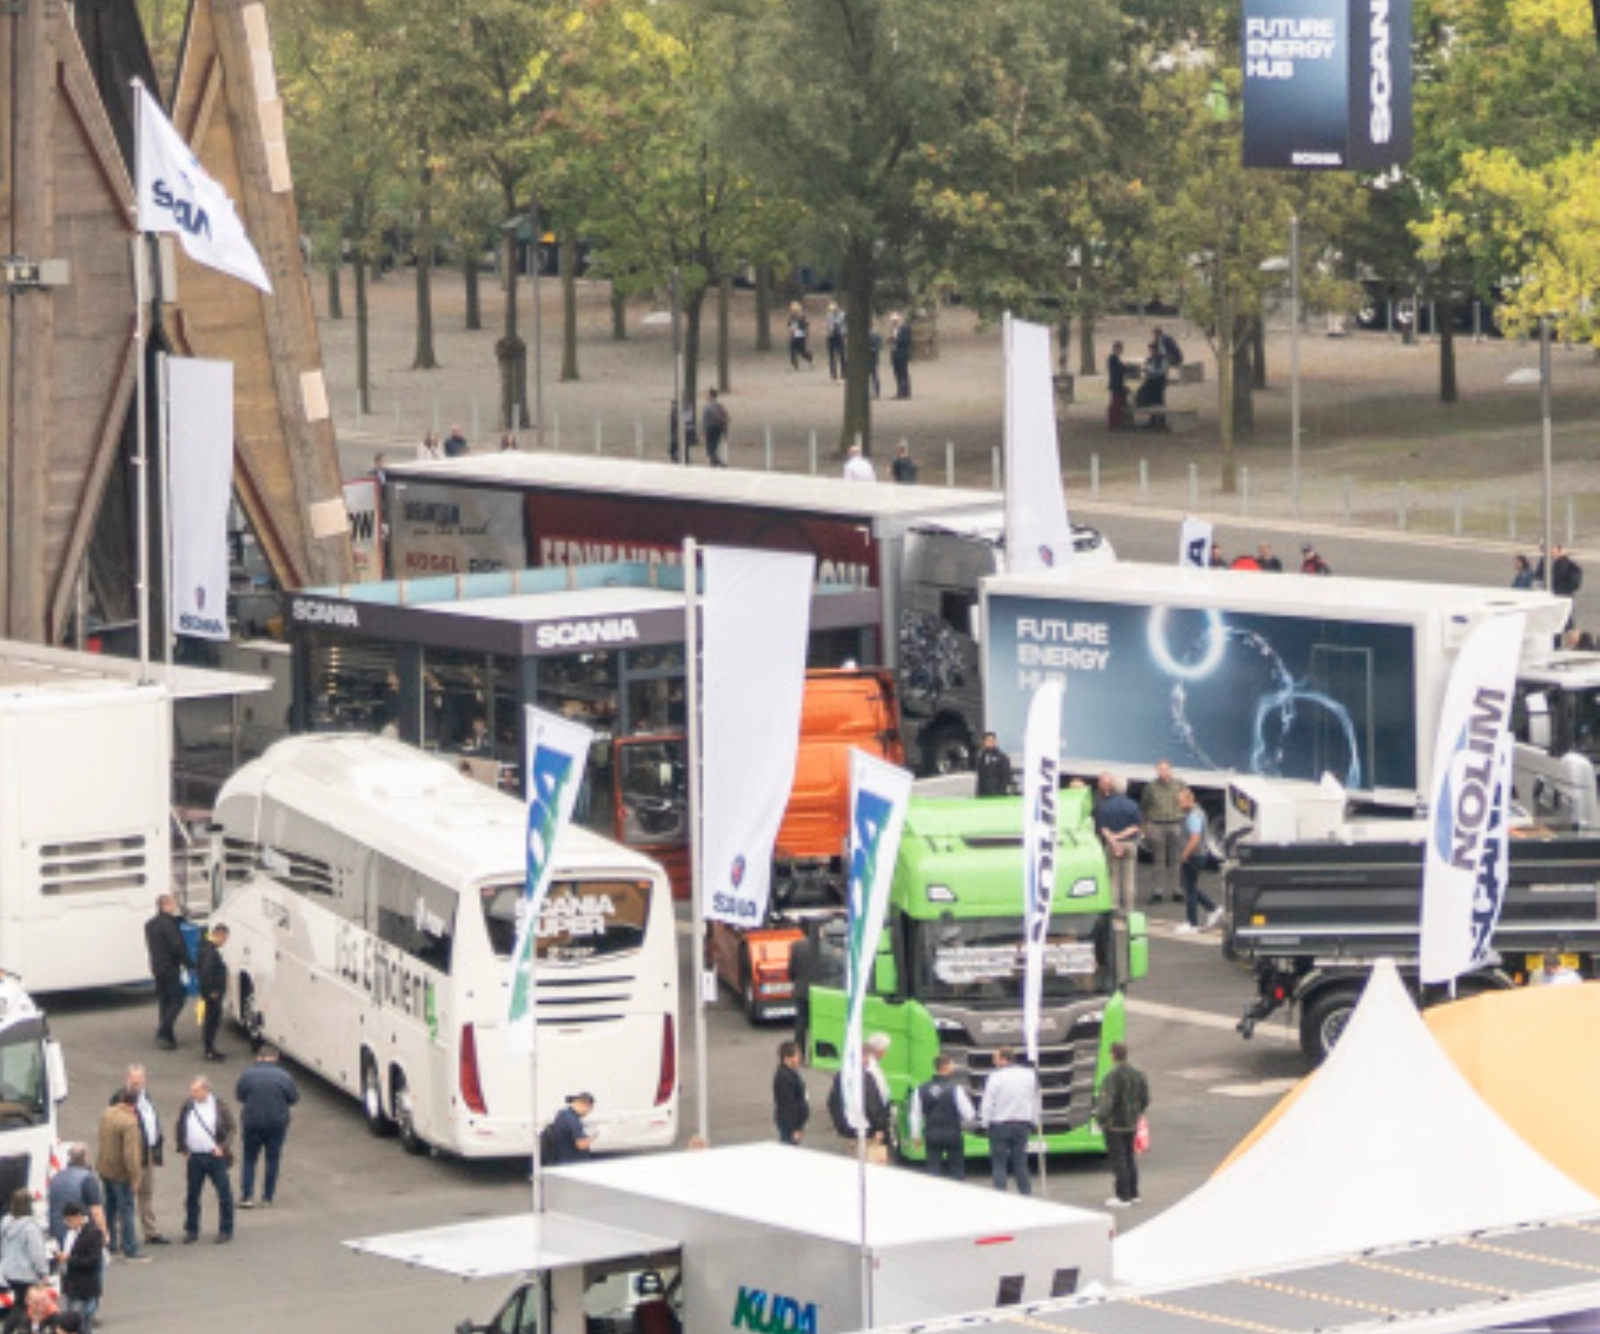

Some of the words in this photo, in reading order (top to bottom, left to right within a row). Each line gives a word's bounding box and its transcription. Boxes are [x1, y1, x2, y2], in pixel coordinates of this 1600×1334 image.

[1247, 17, 1335, 37] FUTURE
[1247, 39, 1335, 58] ENERGY
[1247, 60, 1293, 77] HUB
[293, 600, 360, 627] SCANIA
[537, 619, 639, 648] SCANIA
[1017, 619, 1108, 644] FUTURE
[1017, 644, 1108, 670] ENERGY
